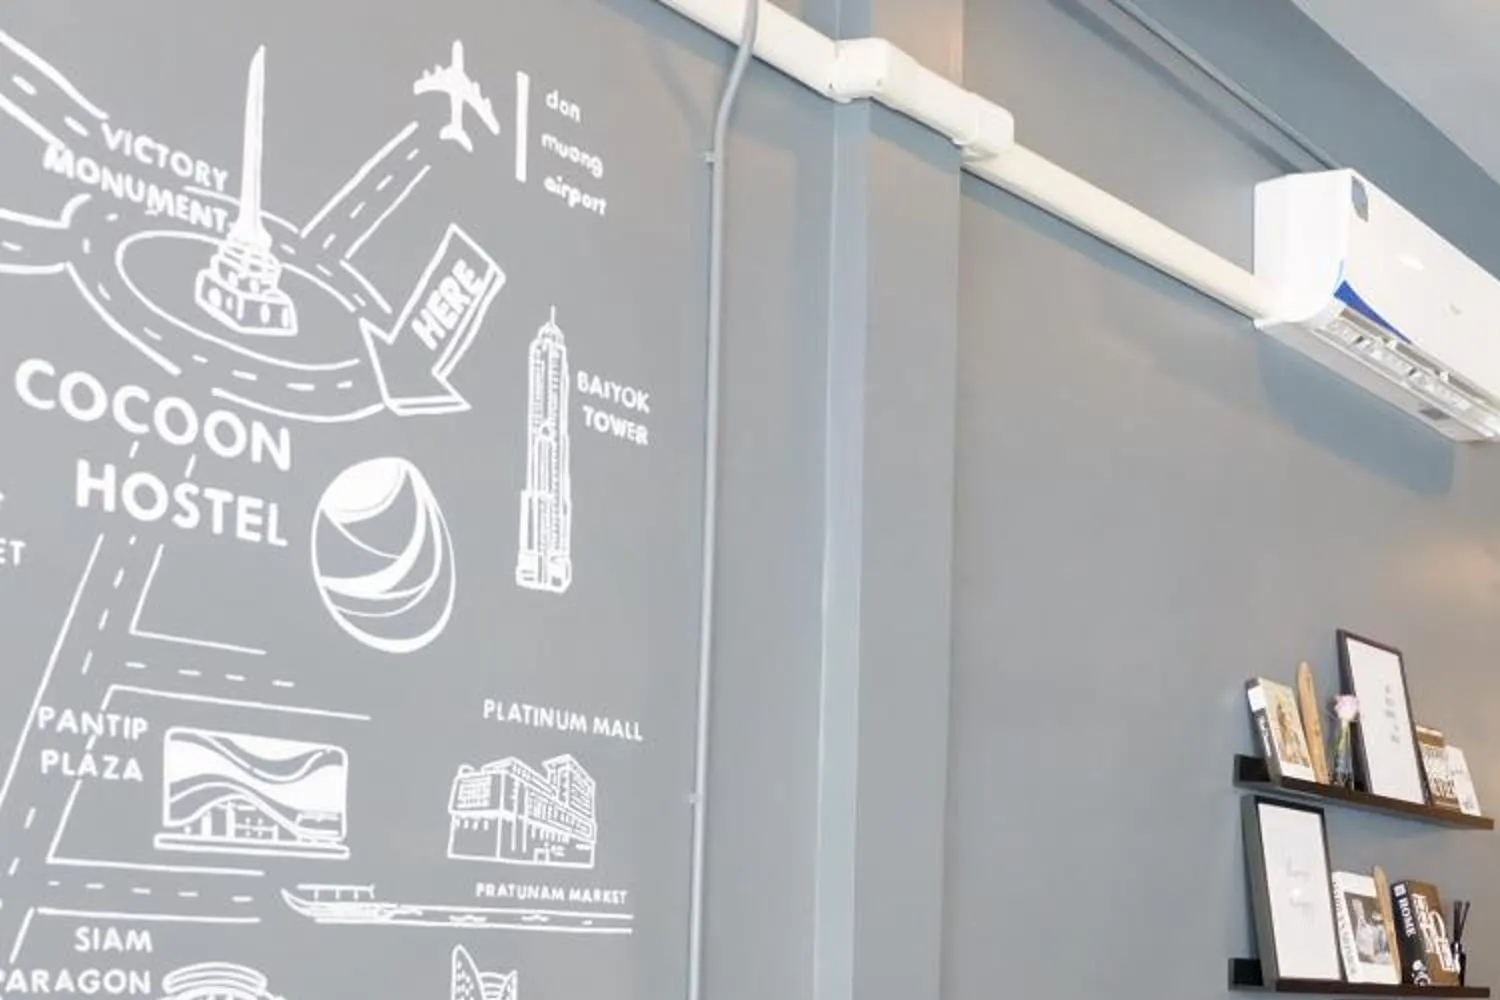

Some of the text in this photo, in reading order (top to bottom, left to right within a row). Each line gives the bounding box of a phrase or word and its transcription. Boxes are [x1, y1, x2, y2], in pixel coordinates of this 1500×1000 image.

[545, 89, 581, 123] don
[101, 122, 229, 191] VICTORY
[541, 133, 604, 179] muong
[43, 142, 228, 233] MONUMENT
[544, 177, 607, 216] airport
[411, 259, 484, 350] HERE
[577, 371, 651, 414] BAIYOK
[15, 359, 291, 471] COCOON
[583, 406, 649, 446] TOWER
[76, 458, 288, 547] HOSTEL
[38, 706, 148, 741] PANTIP
[483, 698, 643, 742] PLATINUM MALL
[41, 749, 144, 782] PLAZA
[476, 882, 628, 906] PRATUNAM MARKET
[74, 925, 153, 953] SIAM
